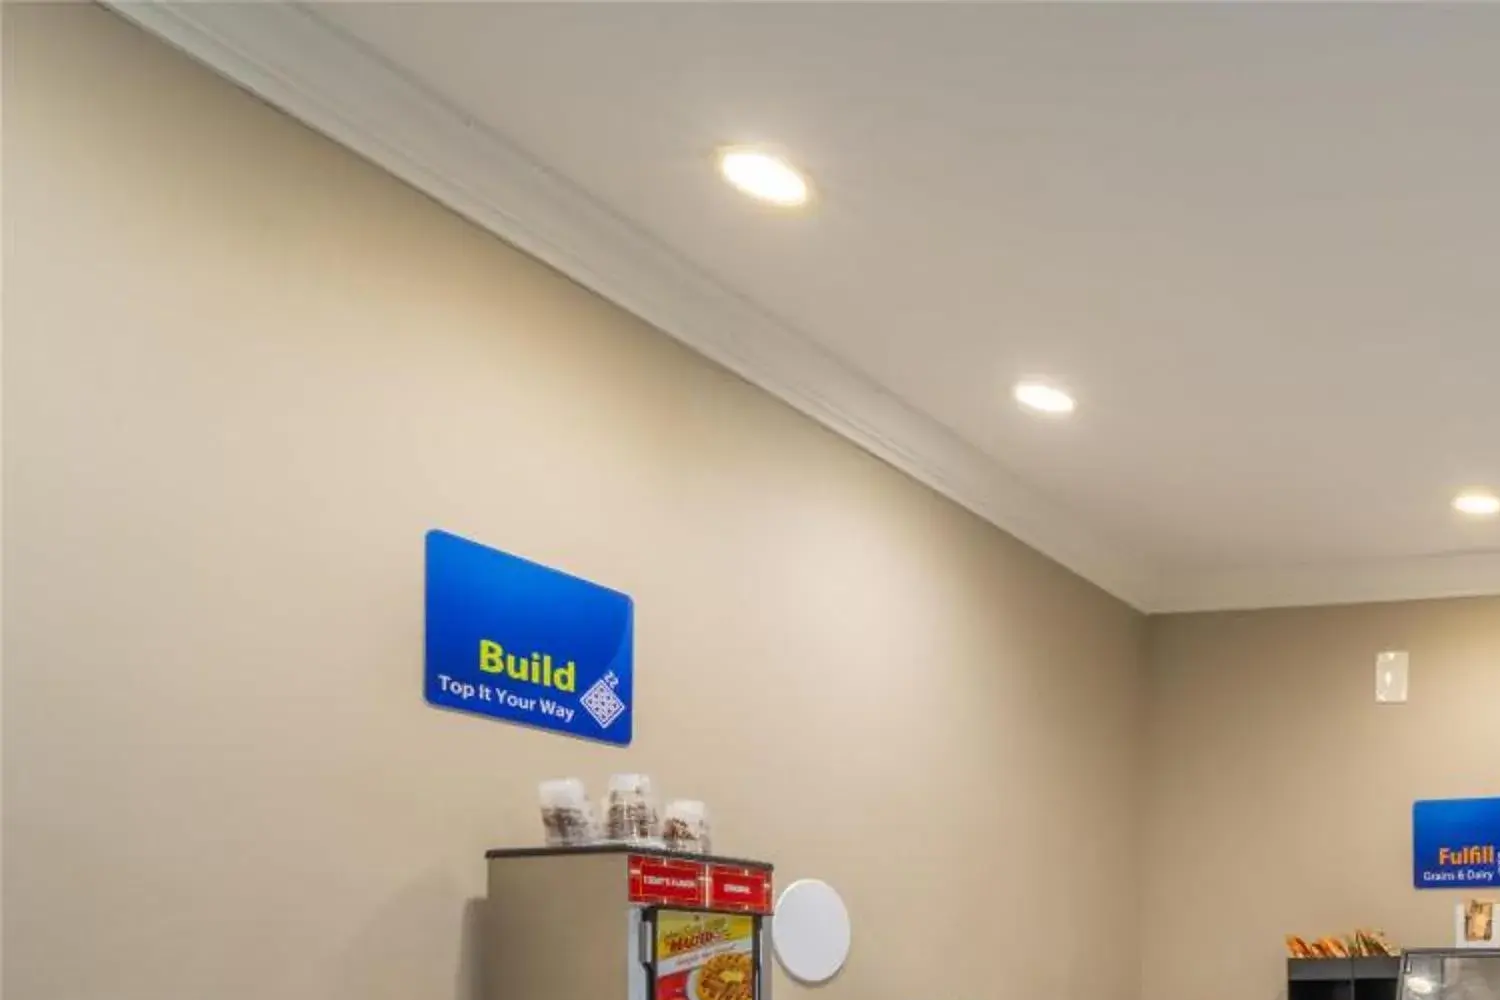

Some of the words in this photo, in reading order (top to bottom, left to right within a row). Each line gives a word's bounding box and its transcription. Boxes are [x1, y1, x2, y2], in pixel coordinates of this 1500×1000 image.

[479, 639, 577, 693] Build
[437, 674, 475, 700] Top
[478, 683, 492, 702] It
[495, 690, 537, 712] Your
[539, 699, 576, 724] Way
[1438, 845, 1495, 866] Fulfill
[1467, 869, 1494, 882] Dairy
